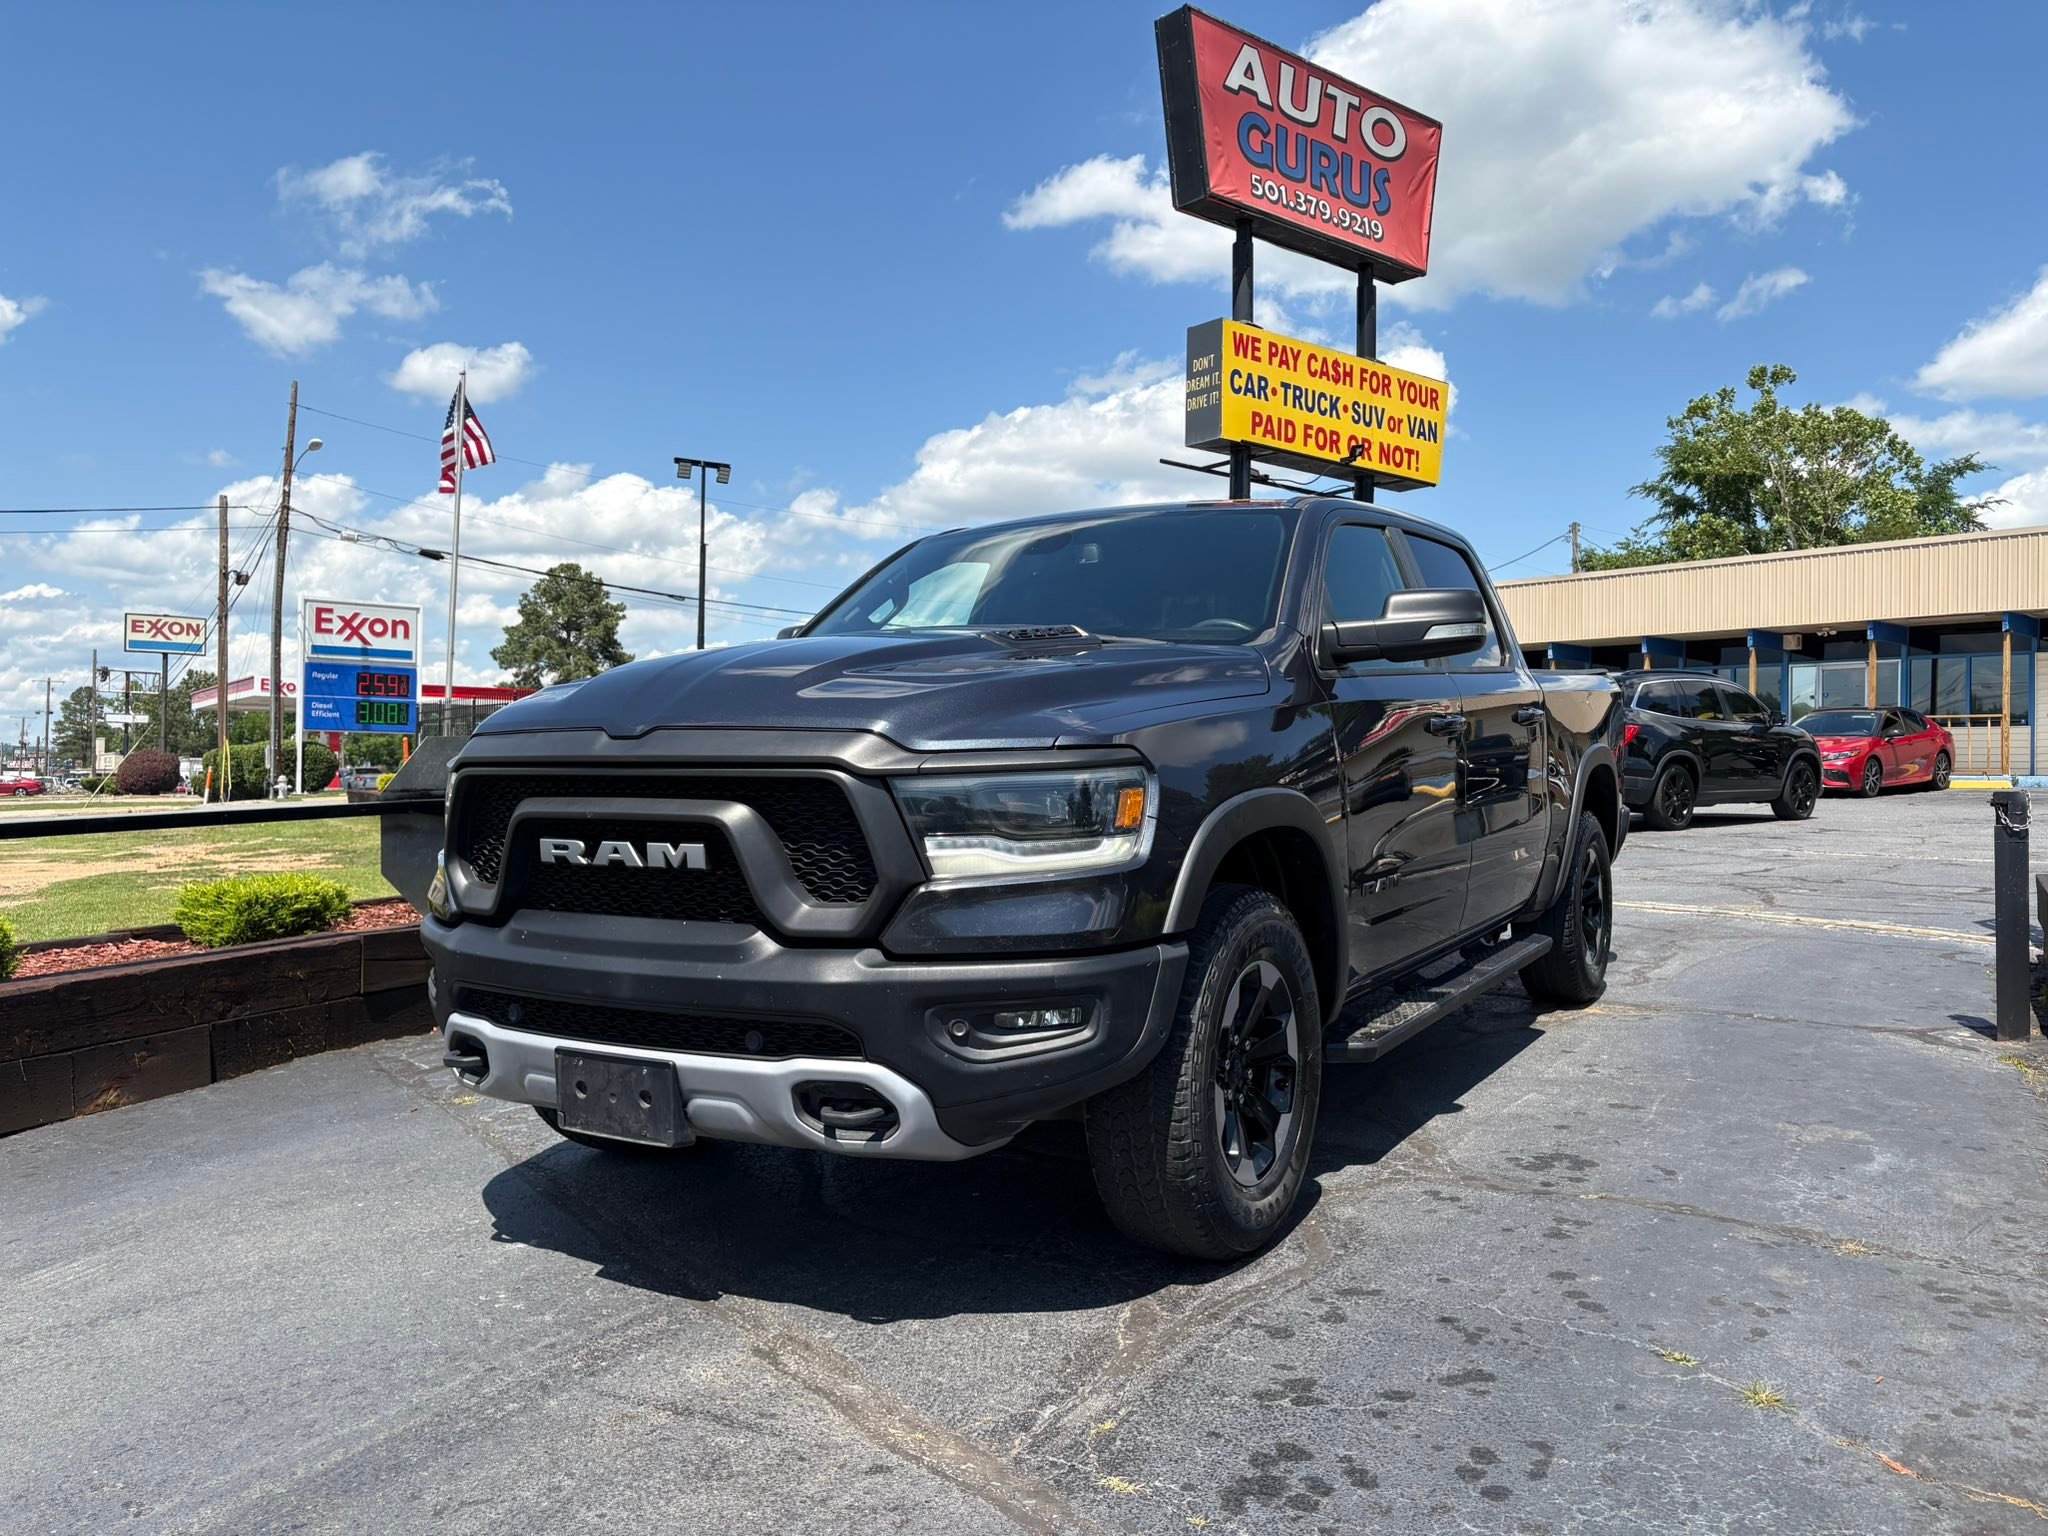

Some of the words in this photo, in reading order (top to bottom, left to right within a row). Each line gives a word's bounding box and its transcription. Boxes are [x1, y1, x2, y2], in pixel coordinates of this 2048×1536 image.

[1223, 43, 1407, 162] AUTO
[1237, 112, 1391, 215] GURUS
[1250, 174, 1384, 241] 501.379.9219
[1193, 354, 1215, 372] DON'T
[1233, 331, 1261, 363] WE
[1268, 341, 1301, 372] PAY
[1306, 352, 1354, 387] CA$H
[1360, 367, 1391, 398] FOR
[1397, 378, 1439, 411] YOUR
[1186, 374, 1210, 392] DREAM
[1187, 393, 1207, 411] DRIVE
[1209, 391, 1219, 404] IT!
[1230, 369, 1269, 401] CAR
[1280, 382, 1341, 420] TRUCK
[1351, 401, 1385, 429] SUV
[1387, 415, 1403, 434] or
[1407, 414, 1438, 444] VAN
[1251, 411, 1296, 443] PAID
[1303, 423, 1341, 454] FOR
[1378, 441, 1420, 472] NOT!
[131, 618, 200, 640] EXXON
[315, 607, 410, 646] Exxon
[312, 671, 338, 680] Regular
[359, 673, 398, 696] 2.59
[312, 701, 332, 709] Diesel
[312, 710, 339, 718] Efficient
[359, 702, 397, 724] 3.08
[539, 838, 706, 870] RAM
